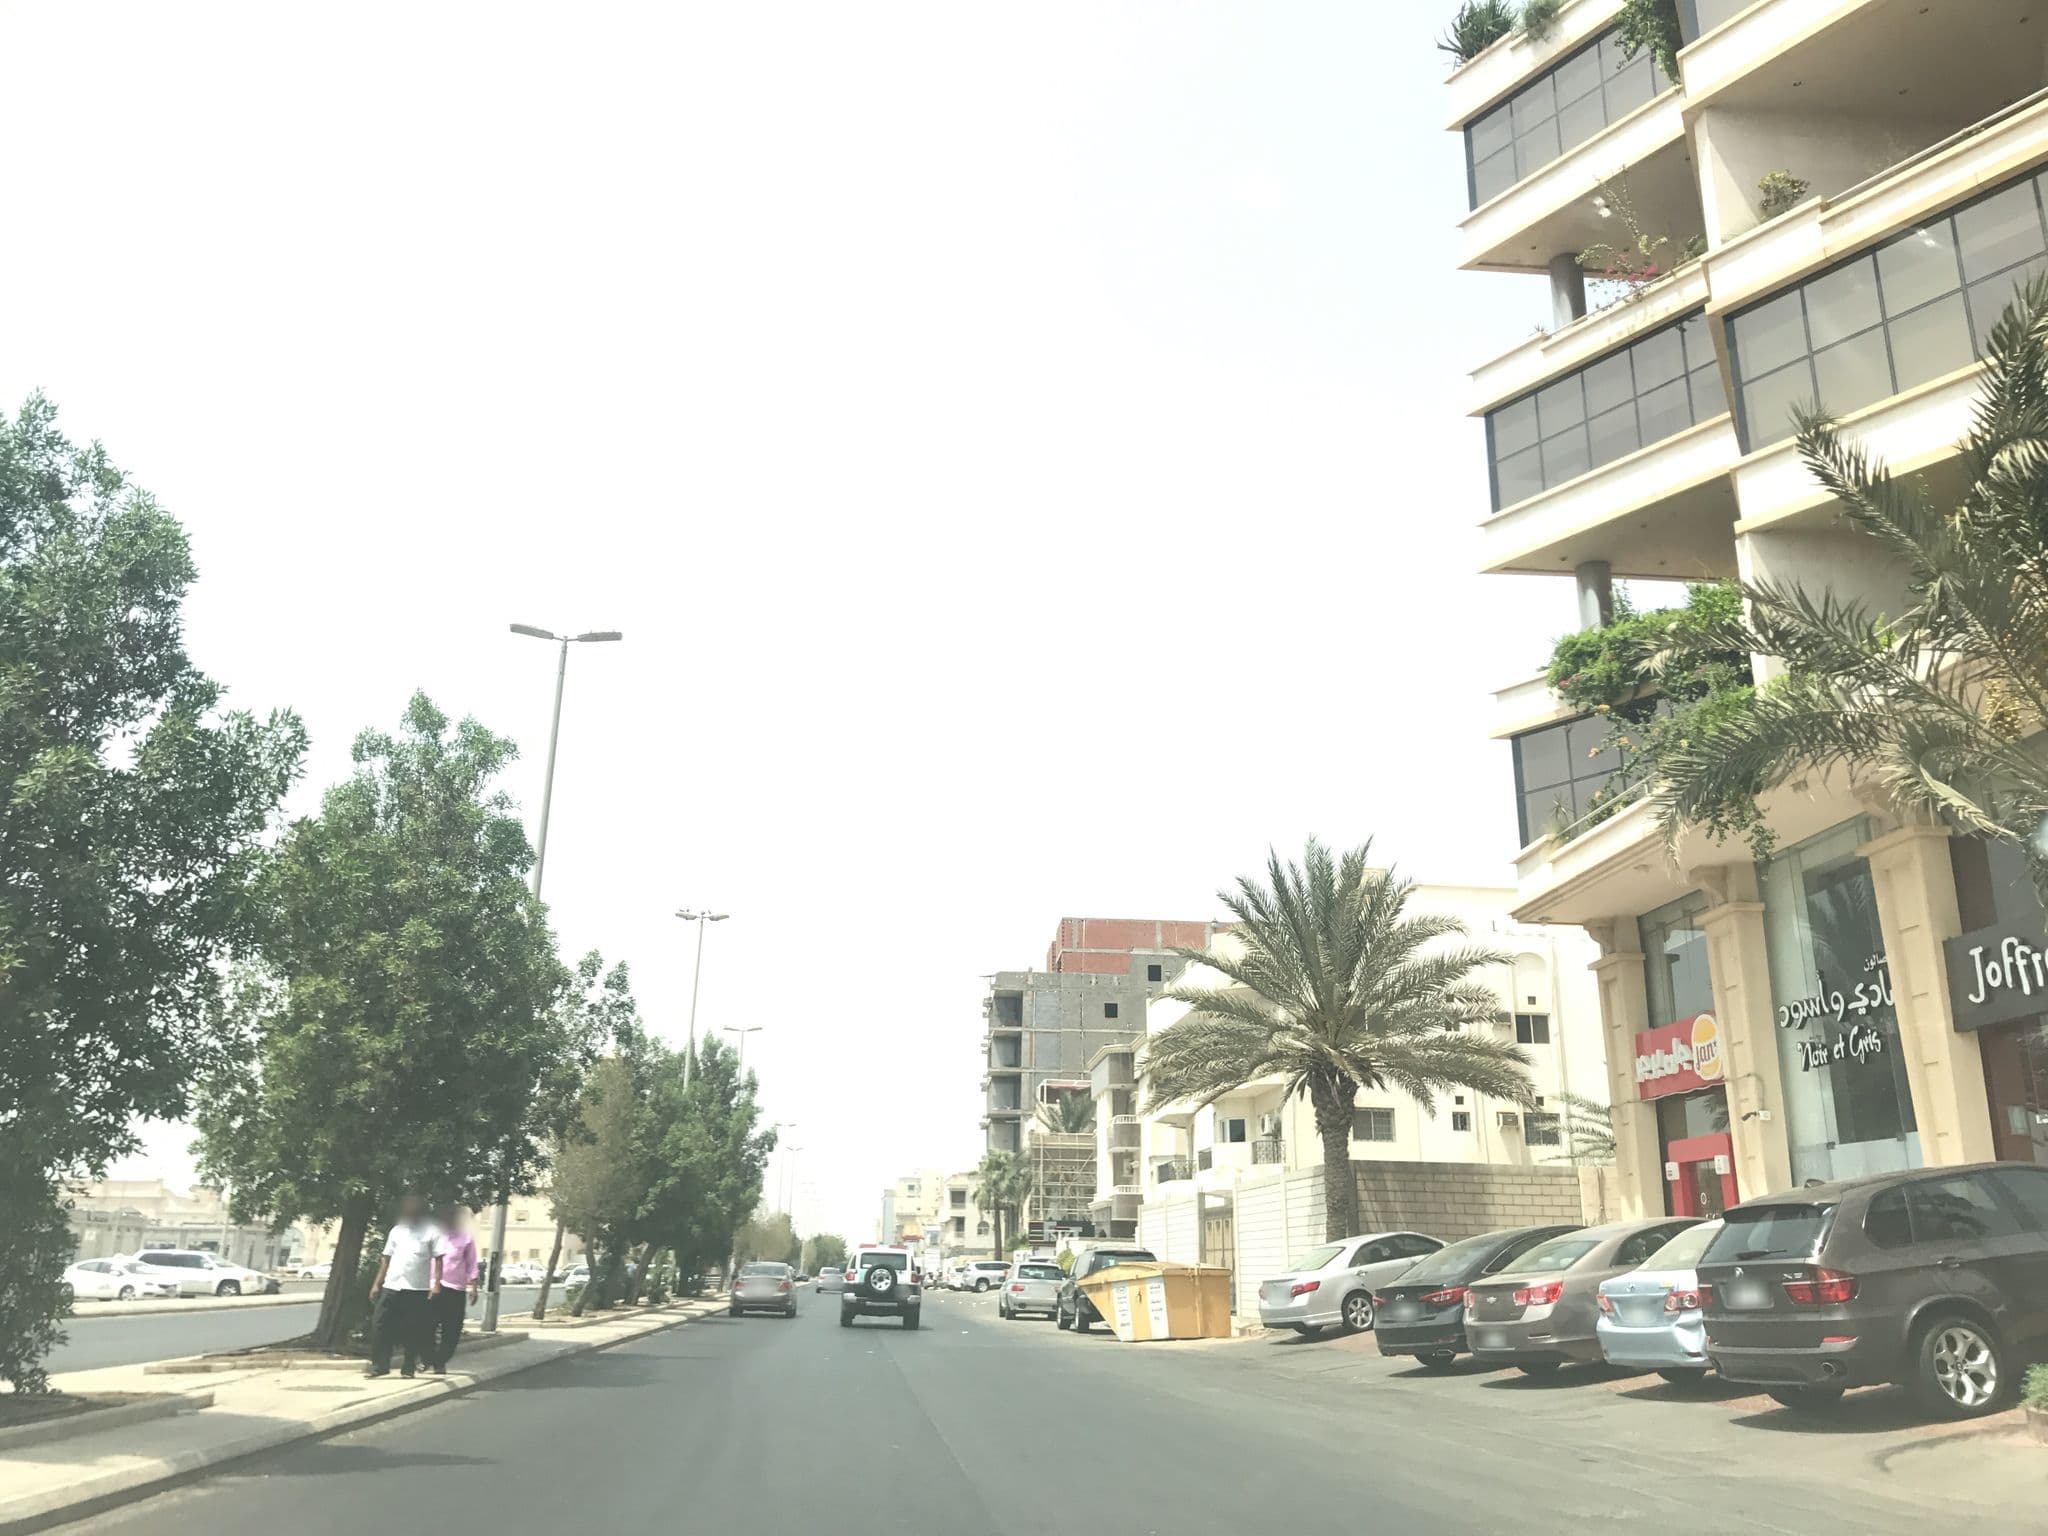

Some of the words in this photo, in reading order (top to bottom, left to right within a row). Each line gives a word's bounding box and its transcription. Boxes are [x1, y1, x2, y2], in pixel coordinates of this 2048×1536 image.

[1968, 936, 2048, 1003] Joffr
[1797, 1042, 1828, 1071] Noir
[1833, 1032, 1845, 1059] et
[1849, 1025, 1881, 1065] Gris
